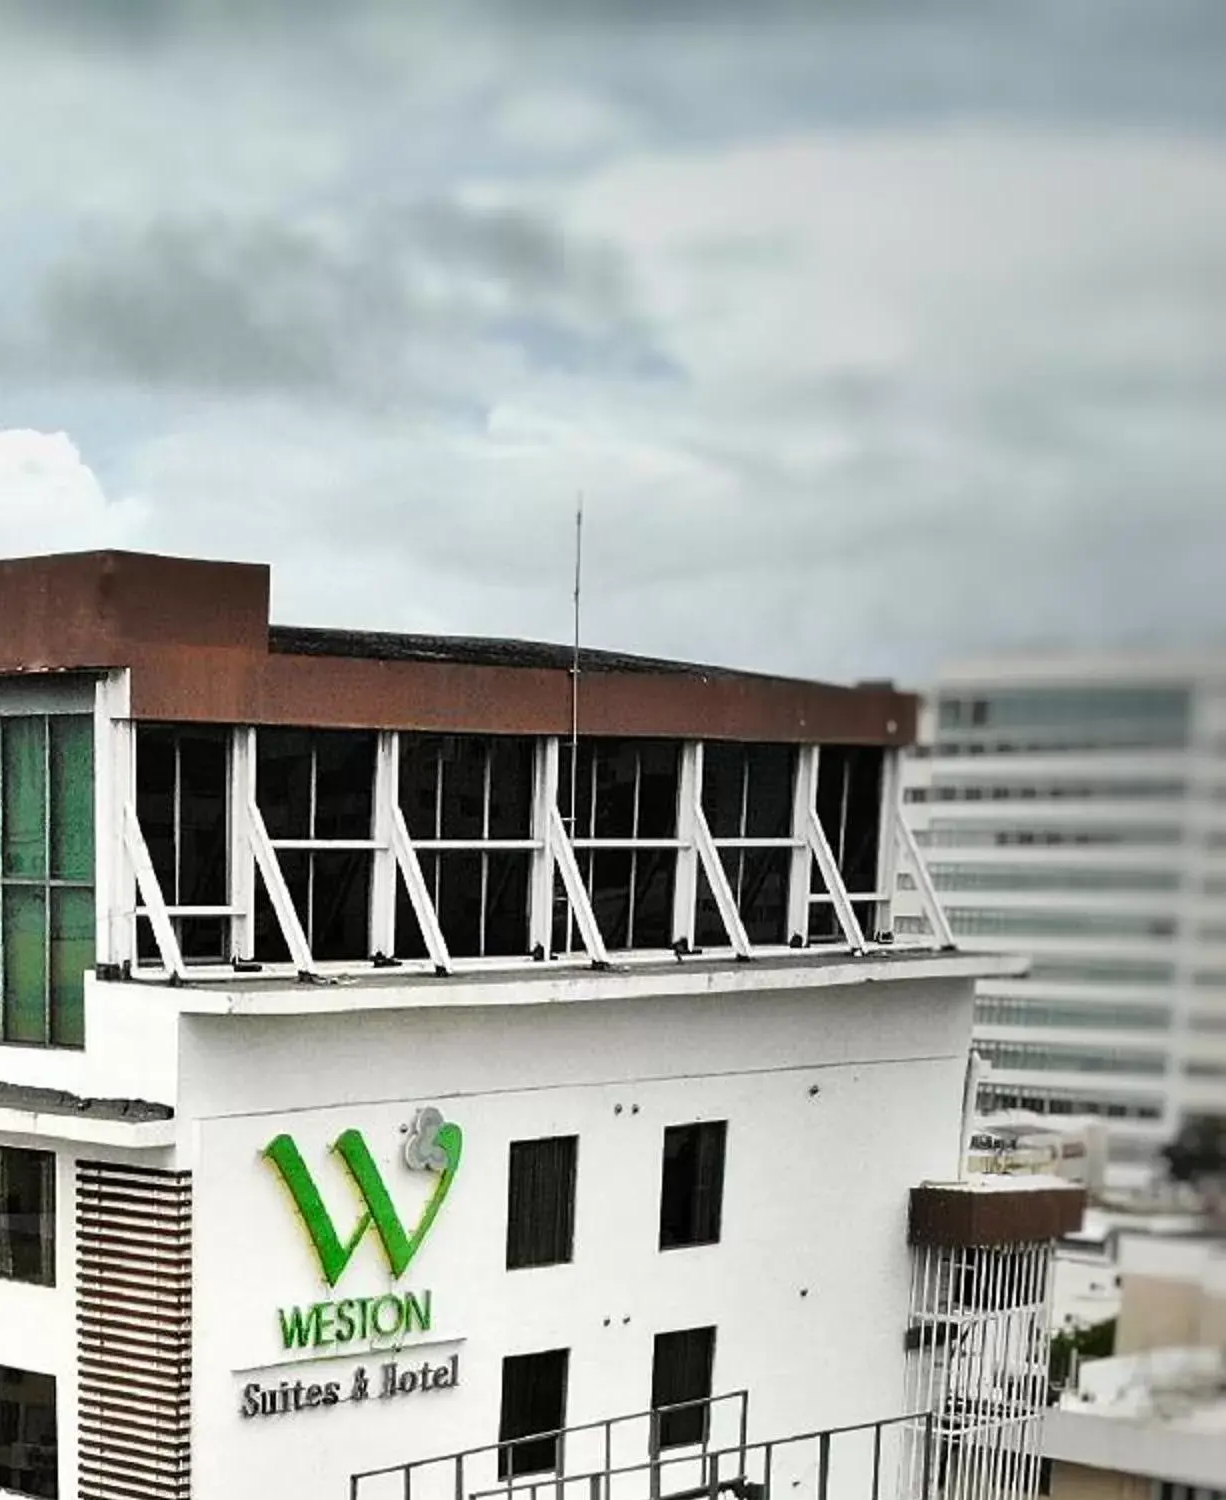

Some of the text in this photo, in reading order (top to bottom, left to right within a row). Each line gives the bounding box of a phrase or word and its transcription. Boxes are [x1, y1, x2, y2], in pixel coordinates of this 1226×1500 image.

[278, 1289, 432, 1349] WESTON
[240, 1381, 341, 1418] Suites
[349, 1366, 370, 1401] &
